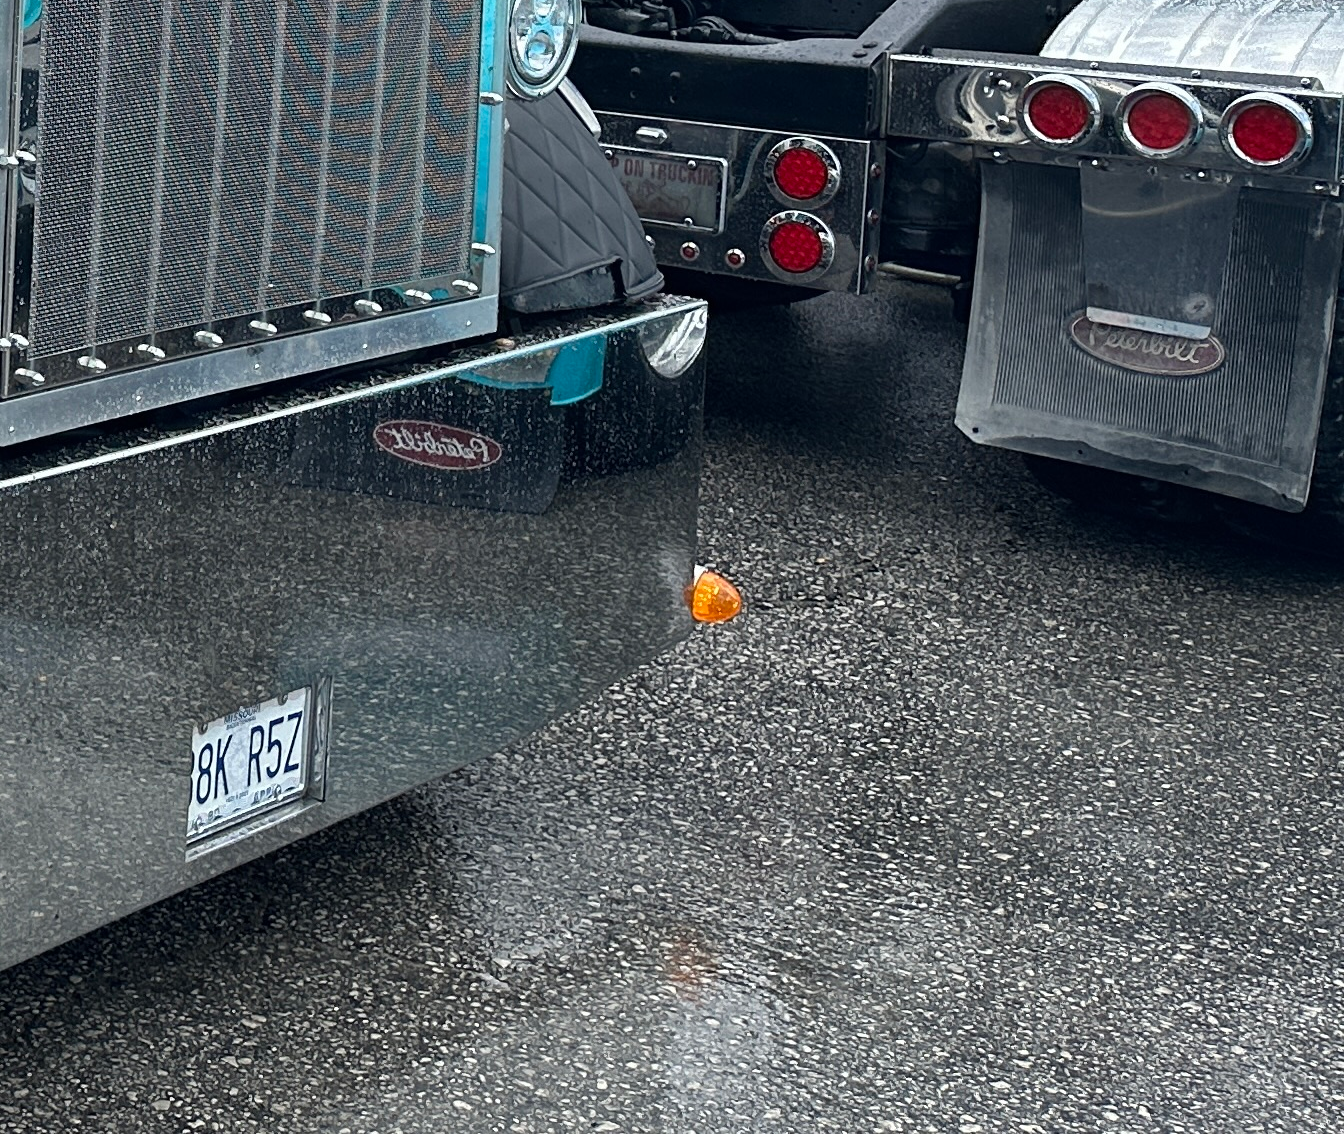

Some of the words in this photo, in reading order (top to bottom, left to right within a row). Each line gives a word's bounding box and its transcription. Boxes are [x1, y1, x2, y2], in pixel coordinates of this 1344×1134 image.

[624, 158, 645, 178] ON
[189, 733, 233, 806] 8K
[247, 710, 303, 788] R5Z
